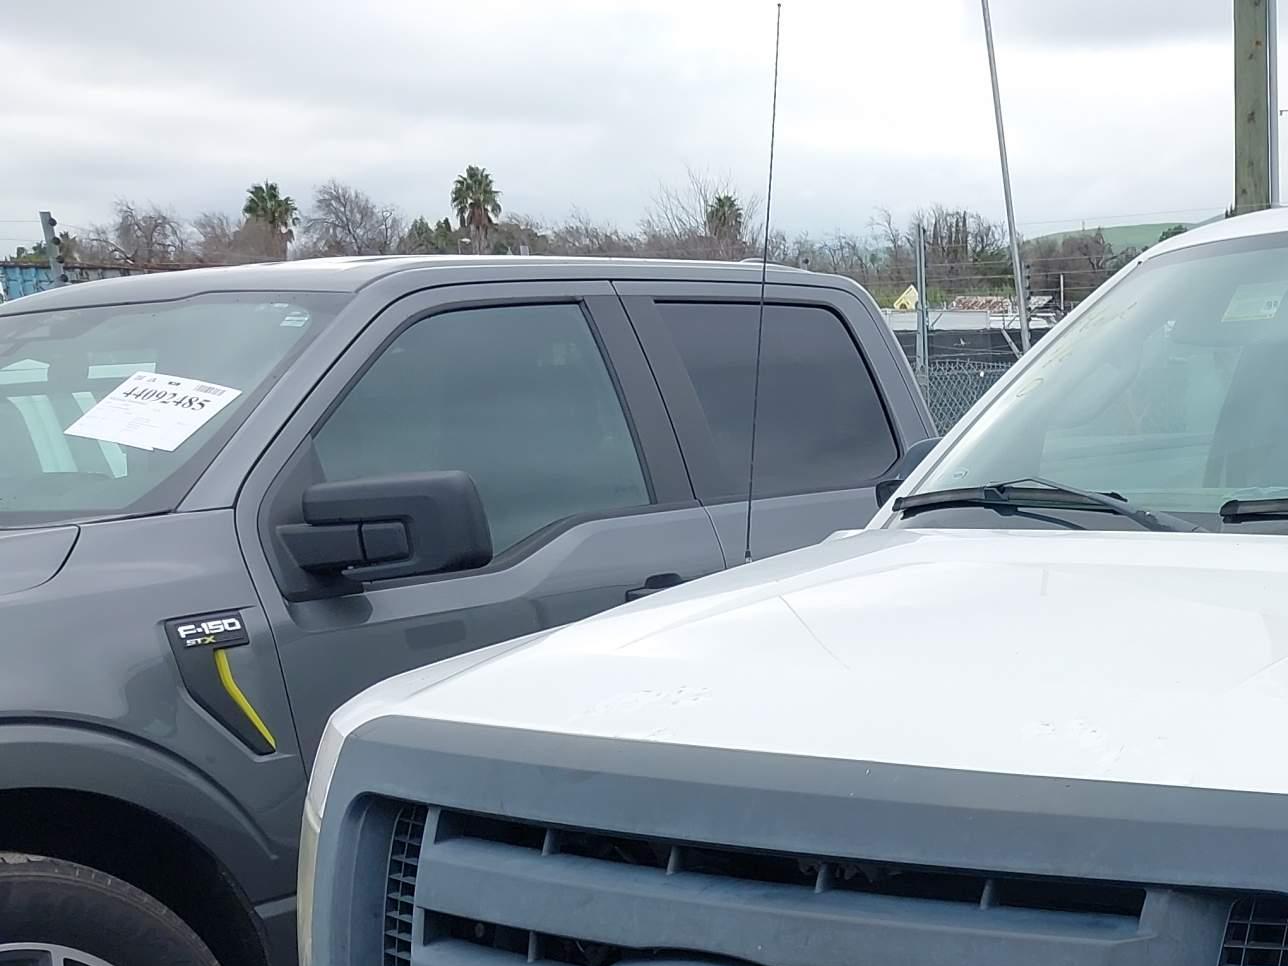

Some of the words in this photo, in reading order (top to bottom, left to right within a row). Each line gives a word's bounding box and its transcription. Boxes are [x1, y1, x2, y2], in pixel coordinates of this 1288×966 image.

[122, 386, 211, 411] 44092485
[177, 618, 241, 638] F-150
[186, 635, 216, 646] STX
